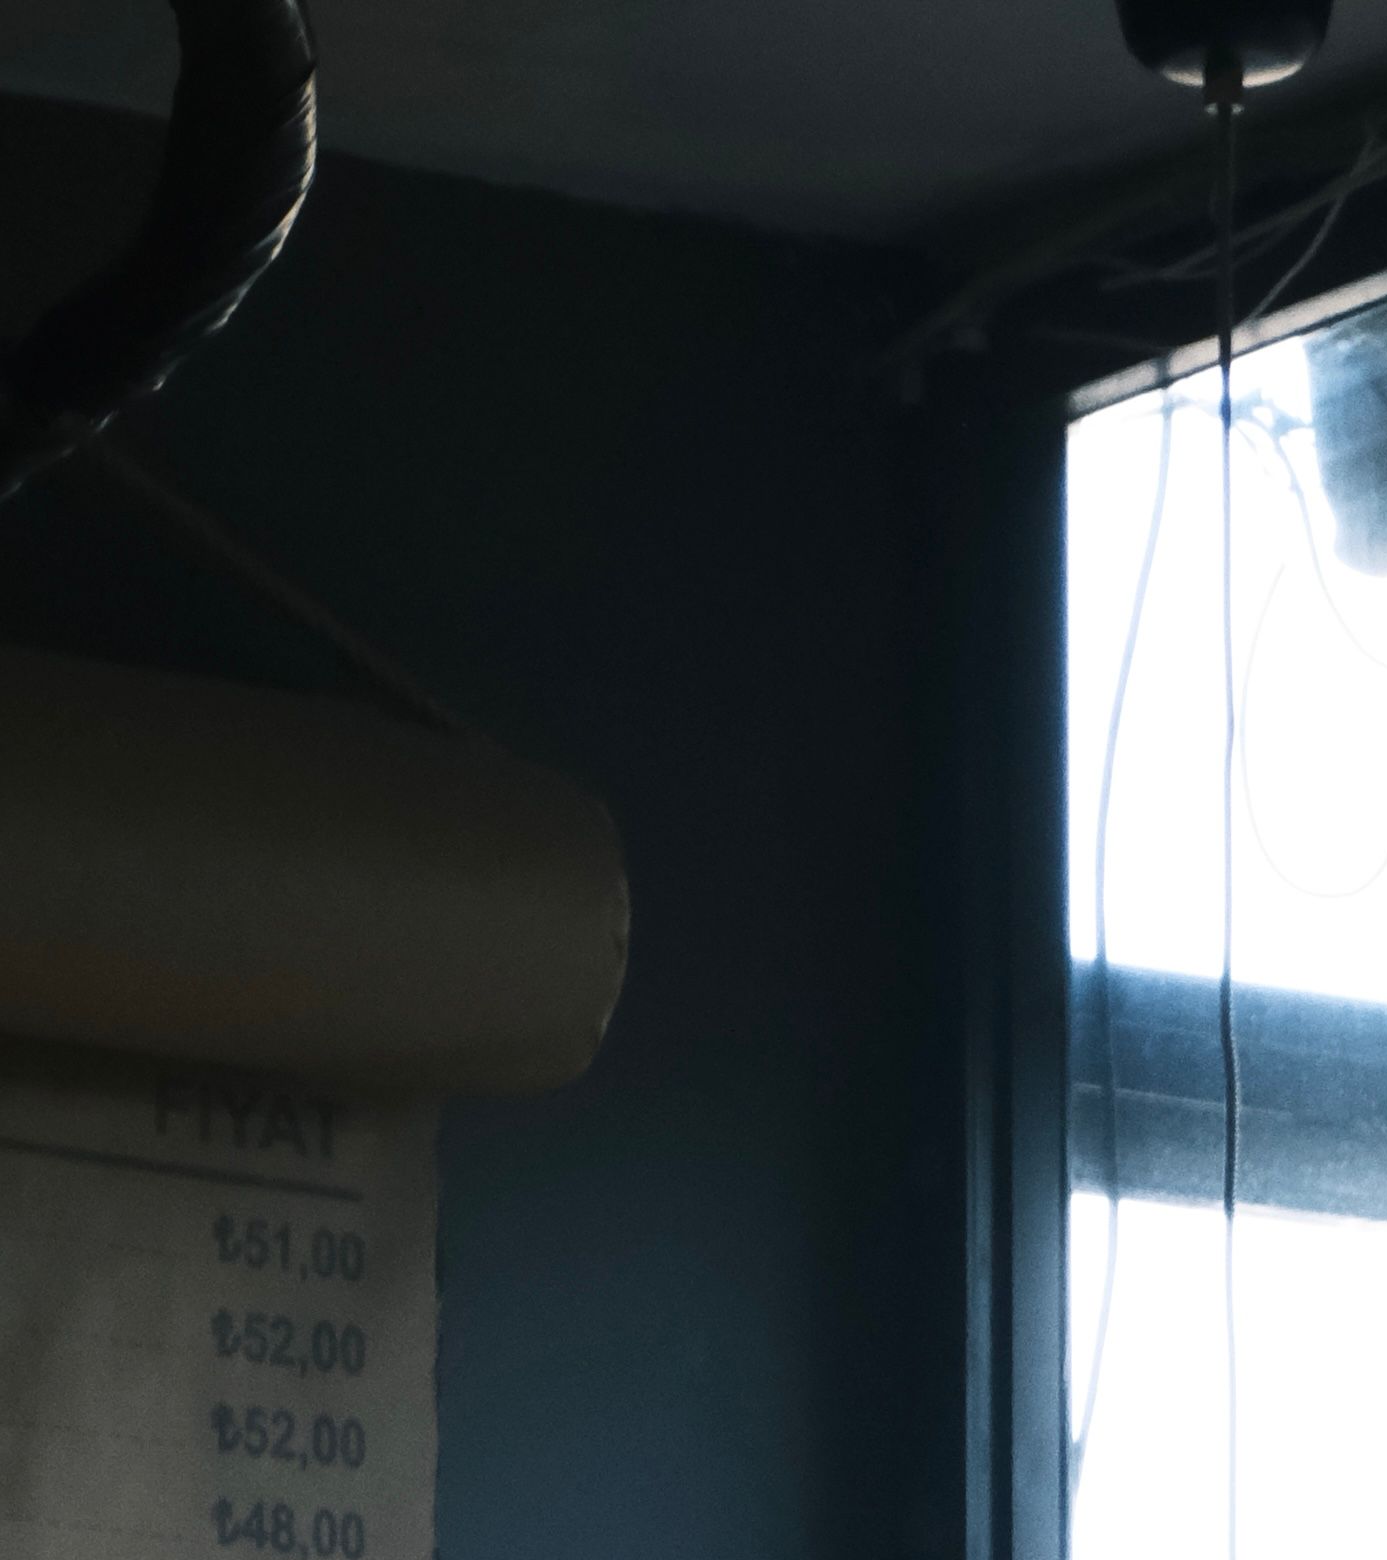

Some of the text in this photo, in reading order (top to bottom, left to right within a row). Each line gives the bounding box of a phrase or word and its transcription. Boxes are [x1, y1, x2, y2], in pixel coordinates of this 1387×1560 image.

[211, 1214, 367, 1283] ₺51,00
[211, 1308, 367, 1378] ₺52,00
[210, 1401, 365, 1470] ₺52,00
